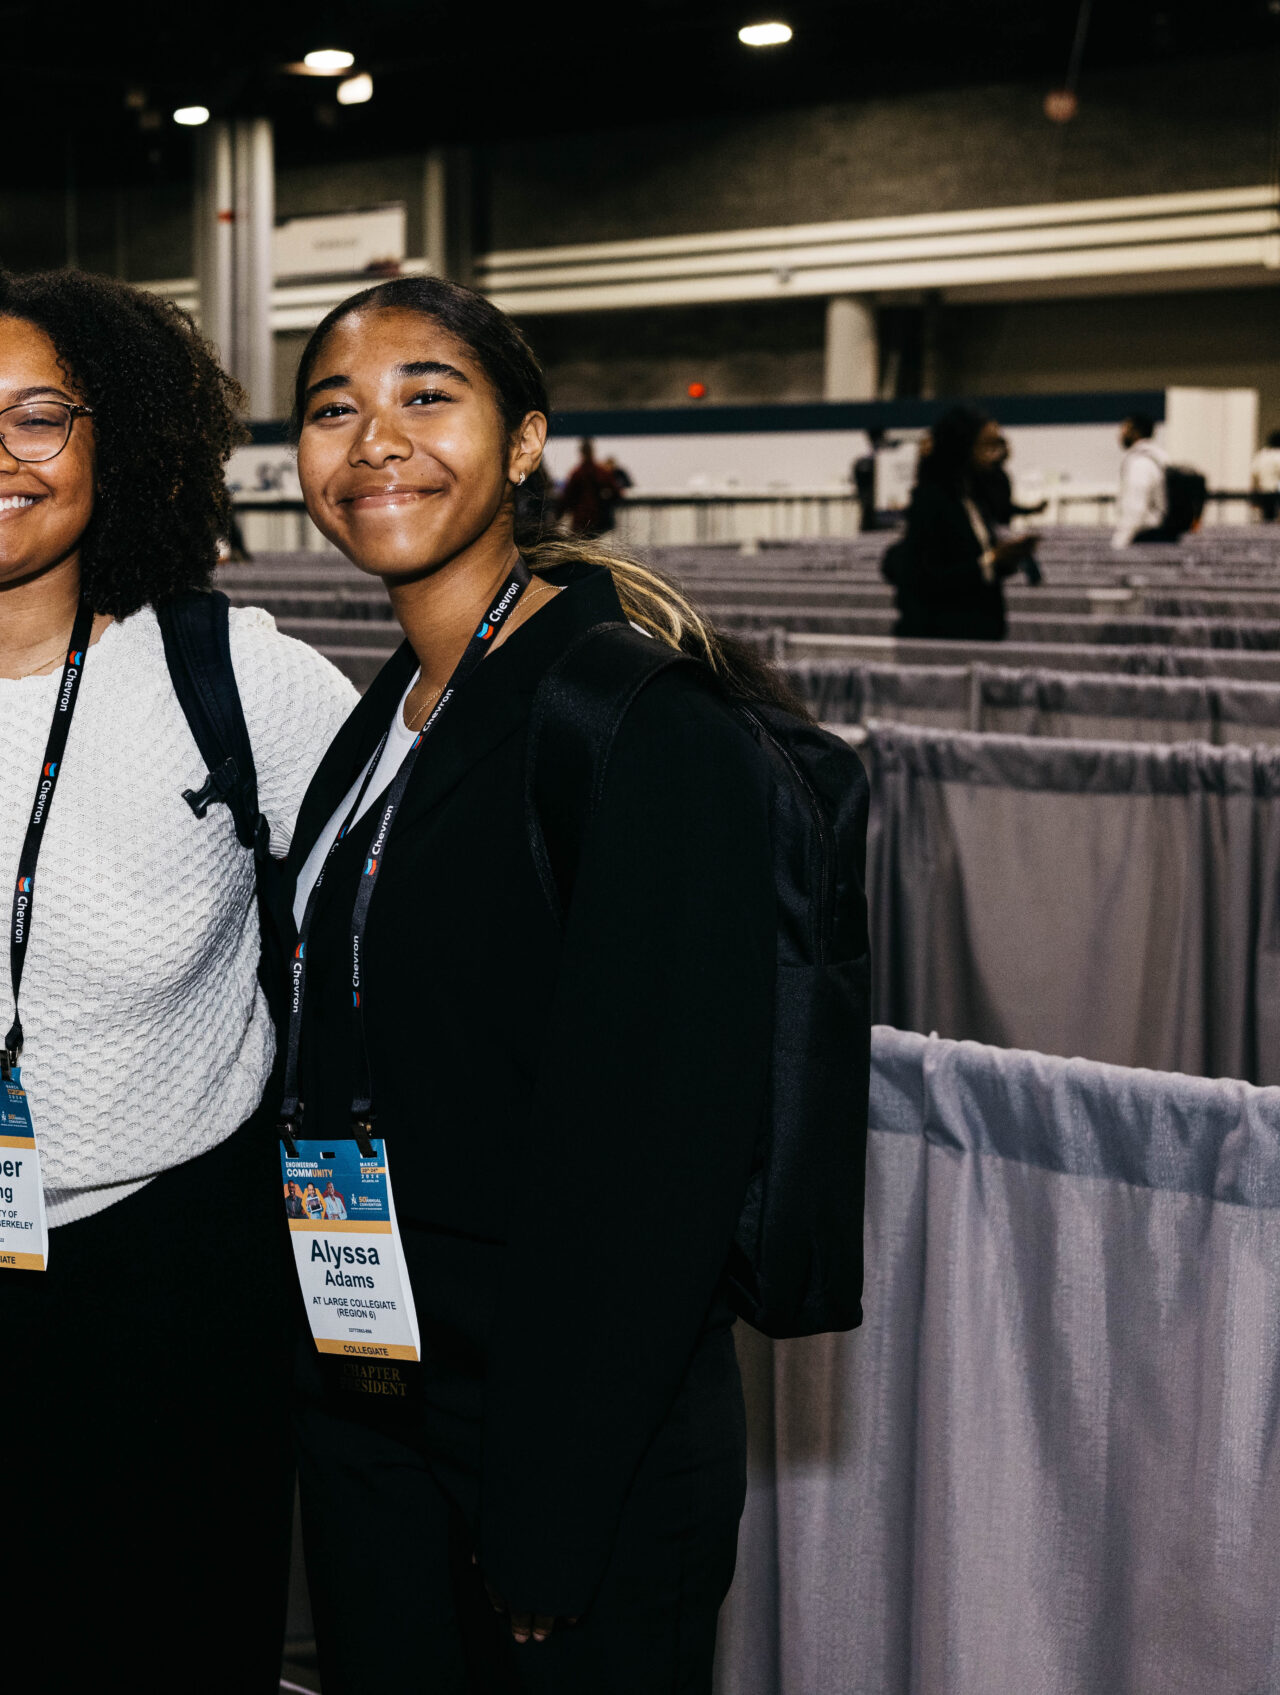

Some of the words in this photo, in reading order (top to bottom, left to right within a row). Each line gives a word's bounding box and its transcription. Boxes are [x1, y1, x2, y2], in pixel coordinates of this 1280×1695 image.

[489, 582, 520, 622] Chevron
[59, 667, 78, 712] Chevron
[422, 688, 454, 732] Chevron
[33, 779, 52, 824] Chevron
[371, 804, 394, 855] Chevron
[16, 895, 28, 944] Chevron
[352, 935, 360, 987] Chevron
[293, 962, 302, 1013] Chevron
[287, 1168, 333, 1178] COMMUNITY
[8, 1210, 18, 1218] OF
[311, 1239, 380, 1269] Alyssa
[325, 1269, 375, 1289] Adams
[312, 1296, 322, 1305] AT
[323, 1297, 349, 1307] LARGE
[350, 1300, 397, 1311] COLLEGIATE
[336, 1308, 368, 1319] (REGION
[369, 1310, 377, 1320] 6)
[343, 1345, 389, 1356] COLLEGIATE
